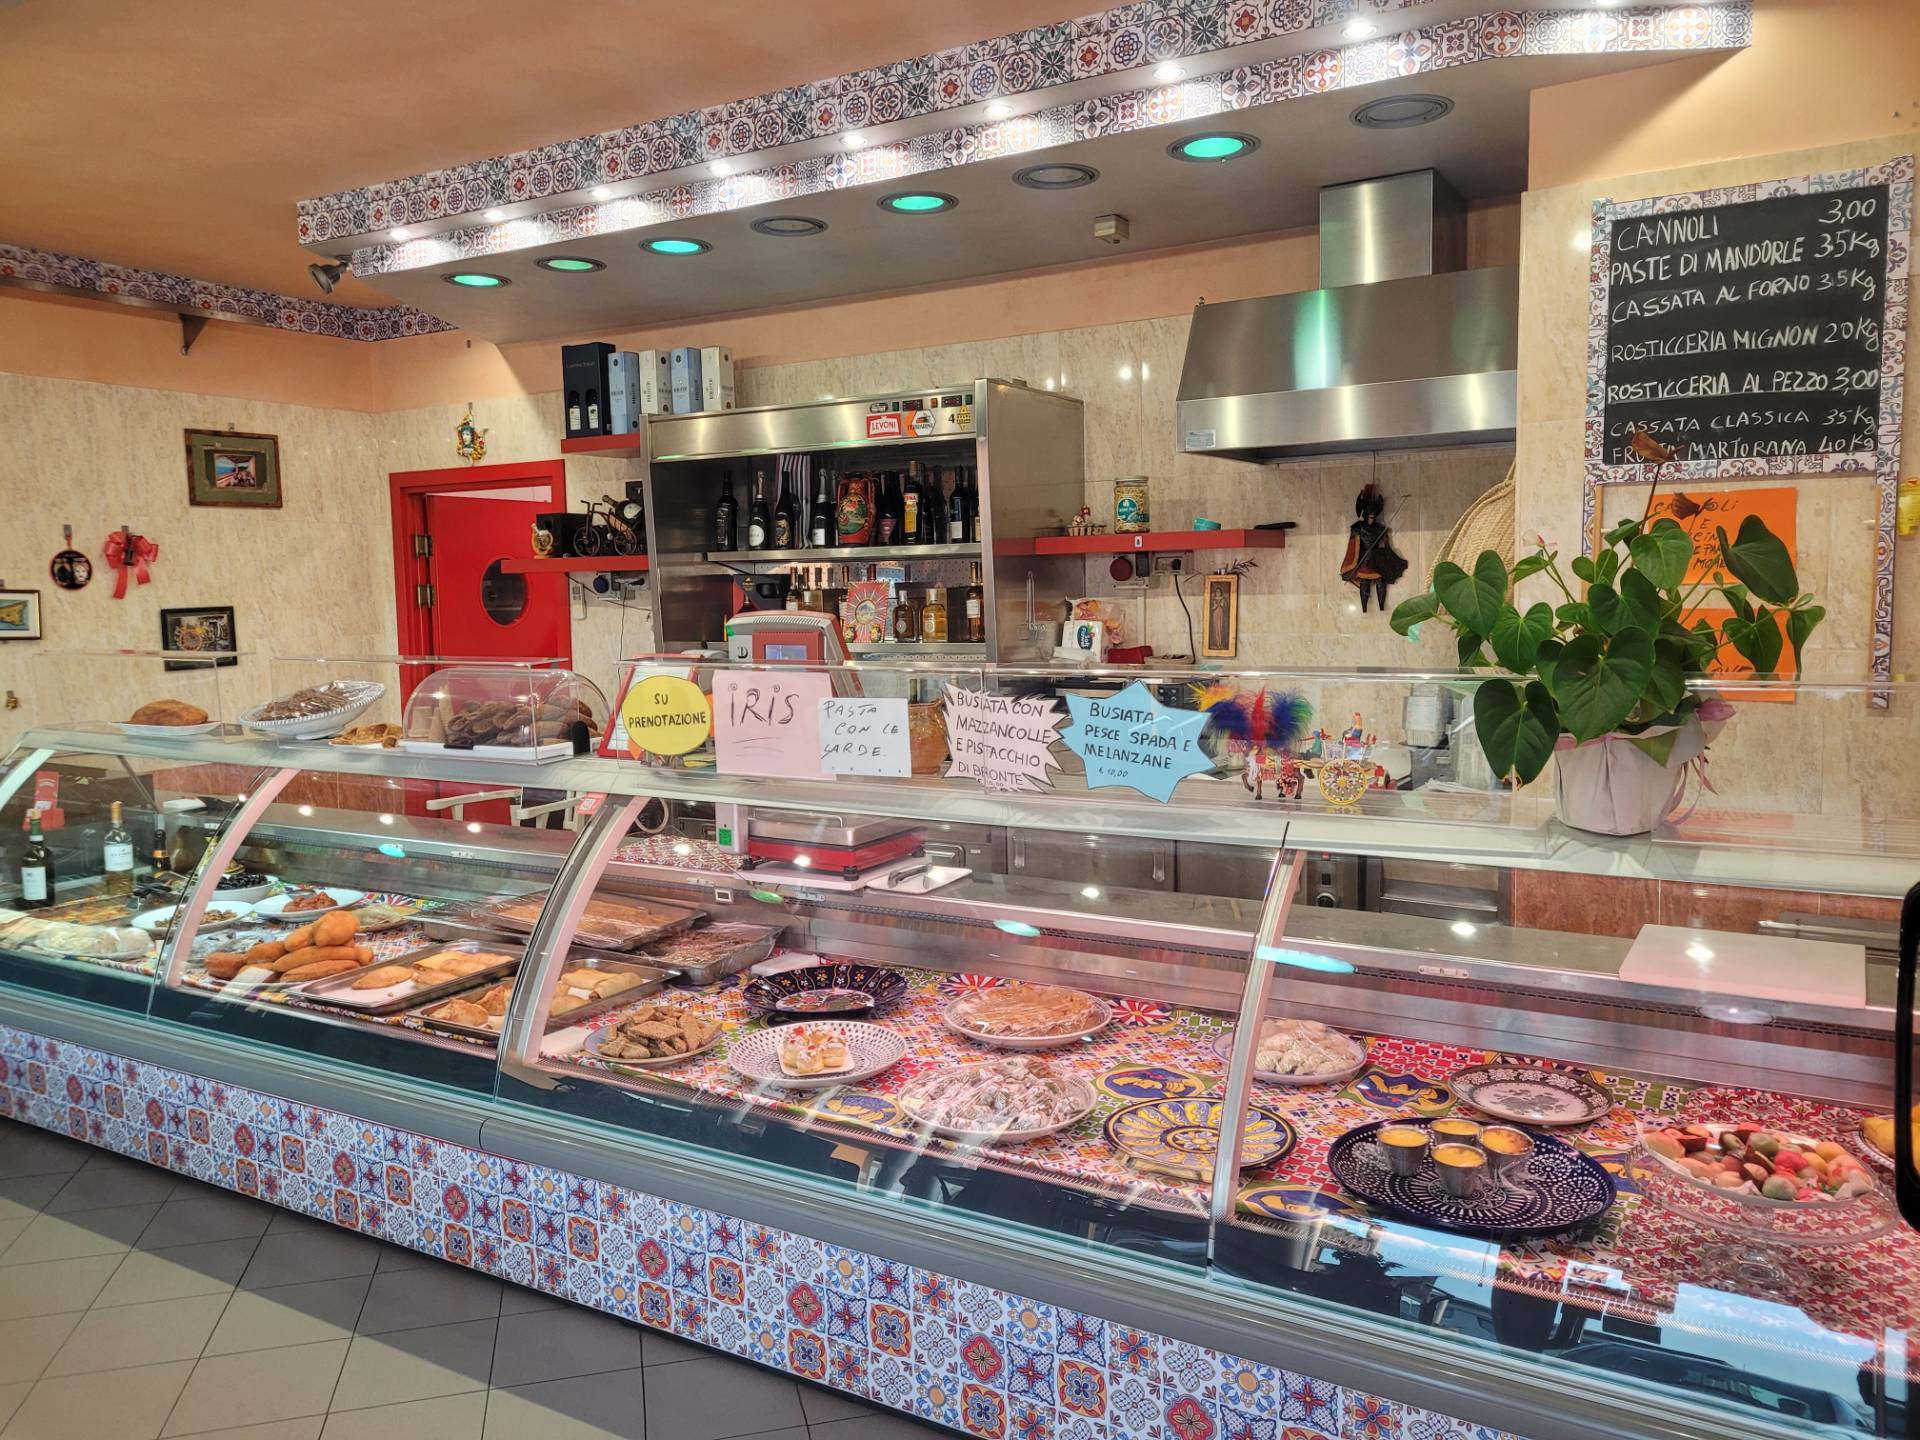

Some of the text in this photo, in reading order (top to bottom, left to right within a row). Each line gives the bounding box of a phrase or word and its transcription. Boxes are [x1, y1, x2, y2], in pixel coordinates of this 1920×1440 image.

[1617, 198, 1877, 251] CANNOLI 3,00
[1610, 254, 1673, 286] PASTE
[1679, 252, 1698, 277] DI
[1705, 236, 1806, 274] MANDORLE
[1611, 288, 1706, 323] CASSATA
[1715, 285, 1742, 305] AL
[1748, 274, 1810, 301] FORNO
[1611, 329, 1728, 363] ROSTICCERIA
[1733, 325, 1819, 350] MIGNON
[1607, 366, 1879, 405] ROSTICCERIA AL PEZZO 3,00
[1610, 416, 1701, 438] CASSATA
[1710, 410, 1811, 429] CLASSICA
[1688, 437, 1808, 461] MARTORANA
[654, 692, 670, 705] SU
[823, 700, 878, 720] PASTA
[956, 691, 1045, 717] BUSIATA CON
[628, 711, 707, 729] PRENOTAZIONE
[1089, 702, 1155, 725] BUSIATA
[834, 722, 899, 736] CON LE
[955, 713, 1052, 745] MAZZANCOLLE
[1084, 724, 1192, 753] PESCE SPADA E
[956, 737, 1041, 767] E PISTACCHIO
[1083, 742, 1173, 769] MELANZANE
[958, 761, 1024, 786] DI BRONTE
